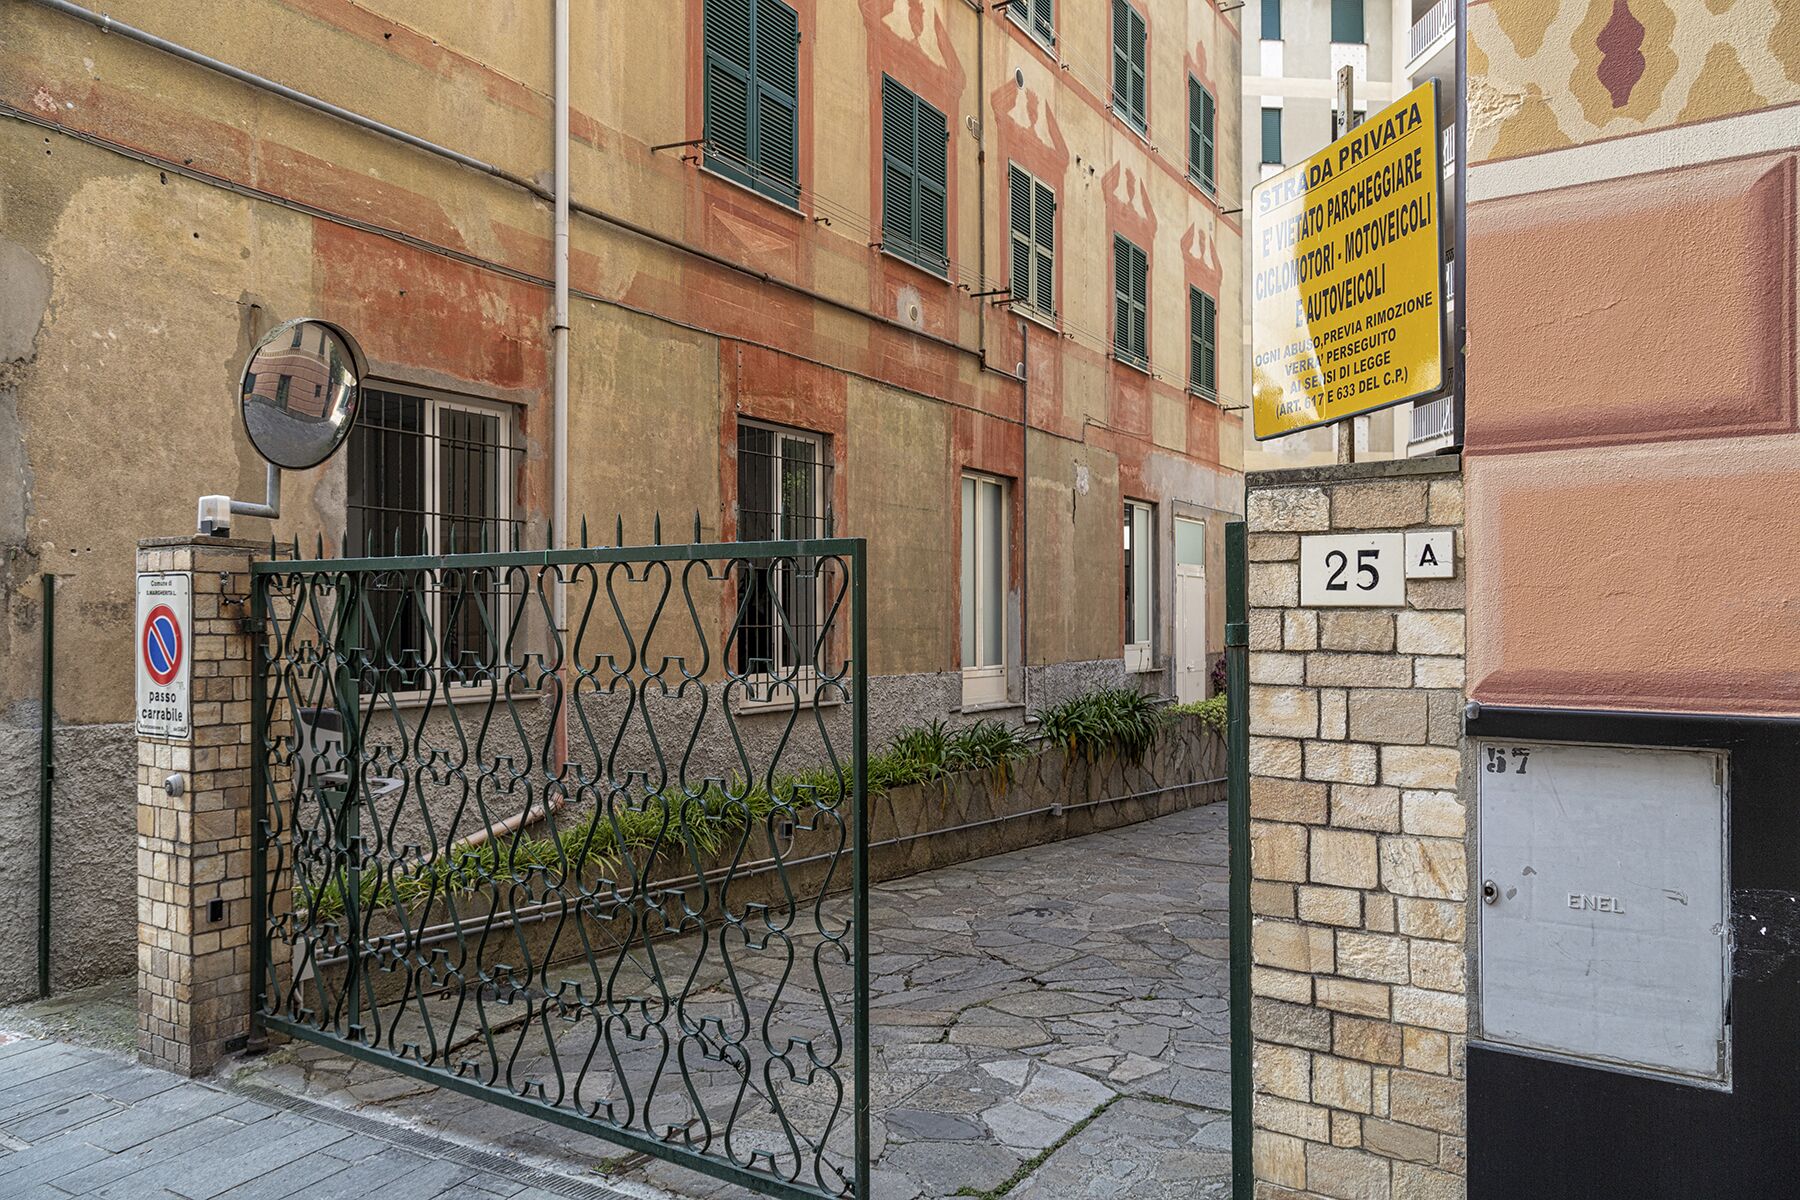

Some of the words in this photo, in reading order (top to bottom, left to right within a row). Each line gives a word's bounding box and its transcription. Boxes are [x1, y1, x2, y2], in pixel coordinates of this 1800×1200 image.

[1260, 158, 1333, 213] STRADA
[1339, 102, 1422, 172] PRIVATA
[1276, 203, 1323, 251] VIETATO
[1328, 146, 1422, 228] PARCHEGGIARE
[1256, 241, 1334, 301] CICLOMOTORI
[1345, 191, 1431, 264] MOTOVEICOLI
[1296, 298, 1303, 328] E
[1307, 263, 1385, 324] AUTOVEICOLI
[1255, 347, 1280, 367] OGNI
[1366, 291, 1432, 329] RIMOZIONE
[1285, 353, 1323, 376] VERRA'
[1327, 327, 1396, 364] PERSEGUITO
[1276, 399, 1301, 420] (ART.
[1304, 392, 1324, 409] 617
[1328, 389, 1334, 403] E
[1337, 383, 1355, 400] 633
[1359, 376, 1380, 394] DEL
[1383, 366, 1408, 384] C.P.)
[1290, 379, 1301, 394] AI
[1304, 369, 1336, 390] SENSI
[1340, 364, 1350, 379] DI
[1354, 350, 1391, 375] LEGGE
[1325, 549, 1380, 591] 25
[1418, 543, 1438, 567] A
[141, 707, 183, 722] carrabile
[149, 691, 177, 704] passo
[1487, 747, 1531, 774] 57
[1567, 891, 1625, 915] ENEL
